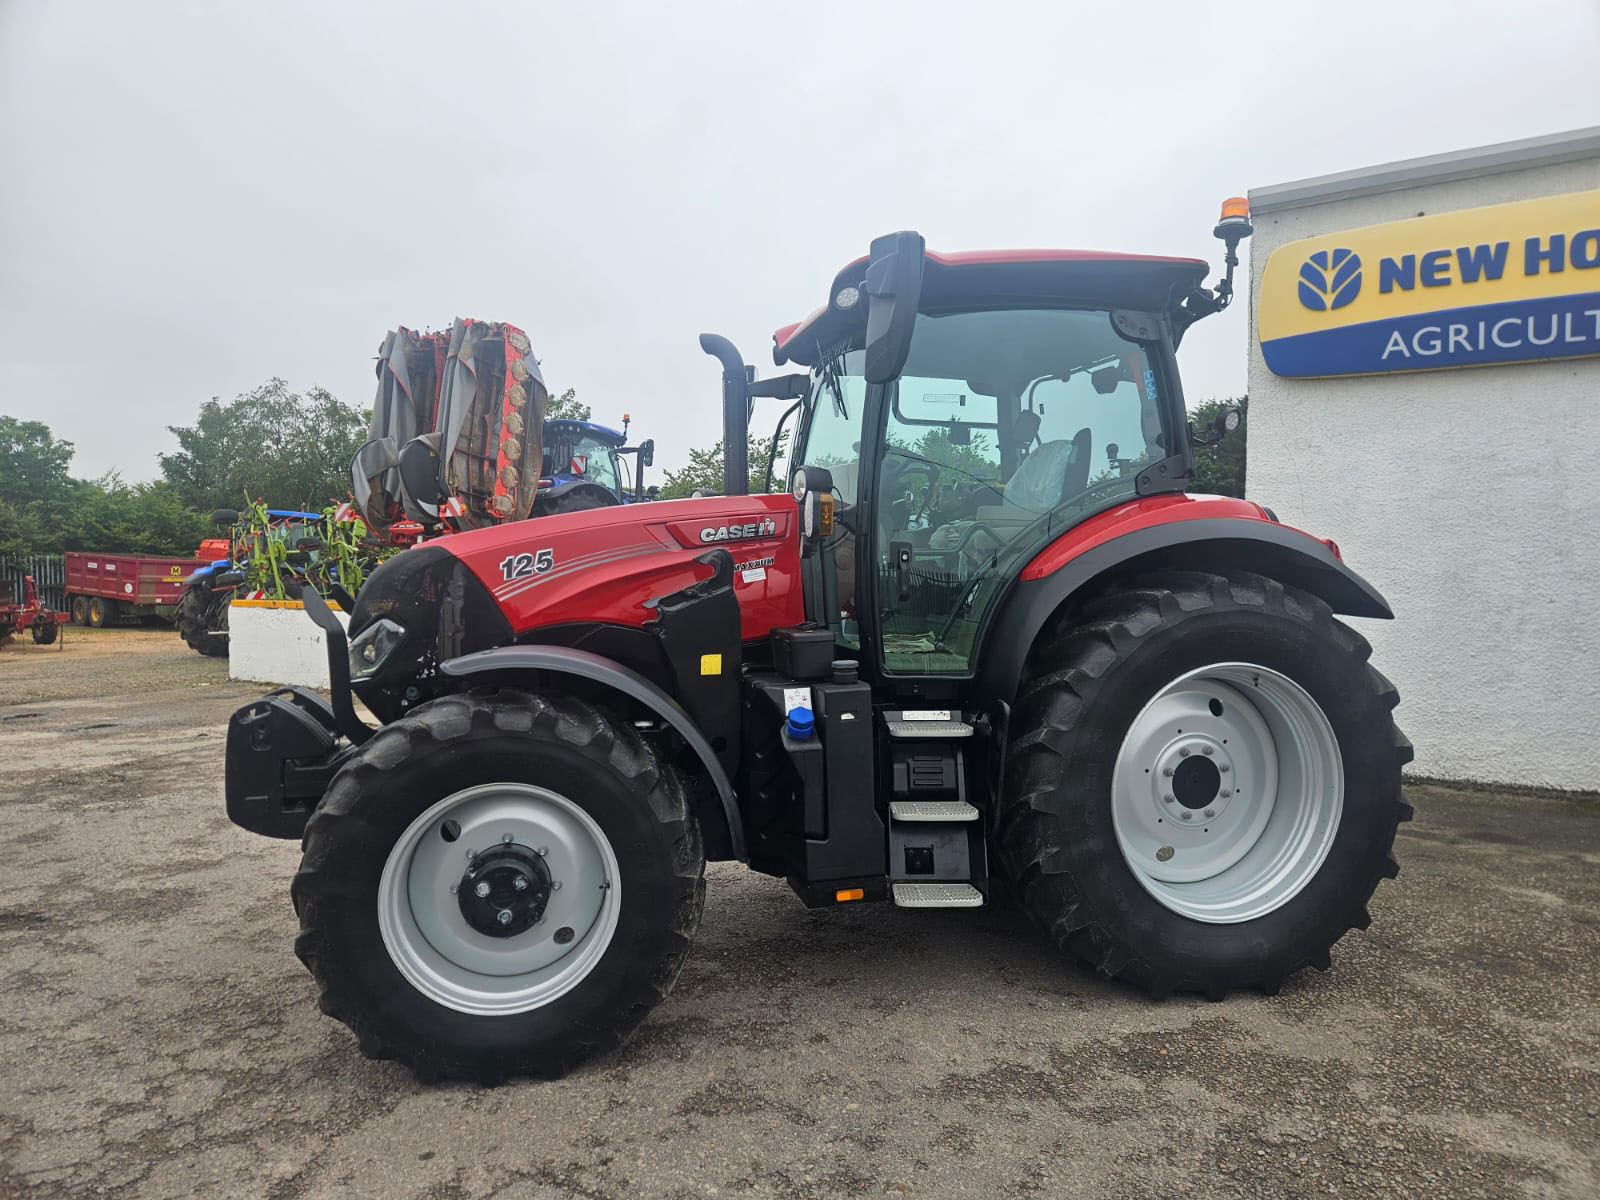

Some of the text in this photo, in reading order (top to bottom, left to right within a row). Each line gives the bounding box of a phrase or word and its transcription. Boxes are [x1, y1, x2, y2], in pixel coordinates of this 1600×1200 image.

[1379, 229, 1600, 294] NEW HO
[700, 523, 756, 542] CASE
[499, 548, 554, 580] 125
